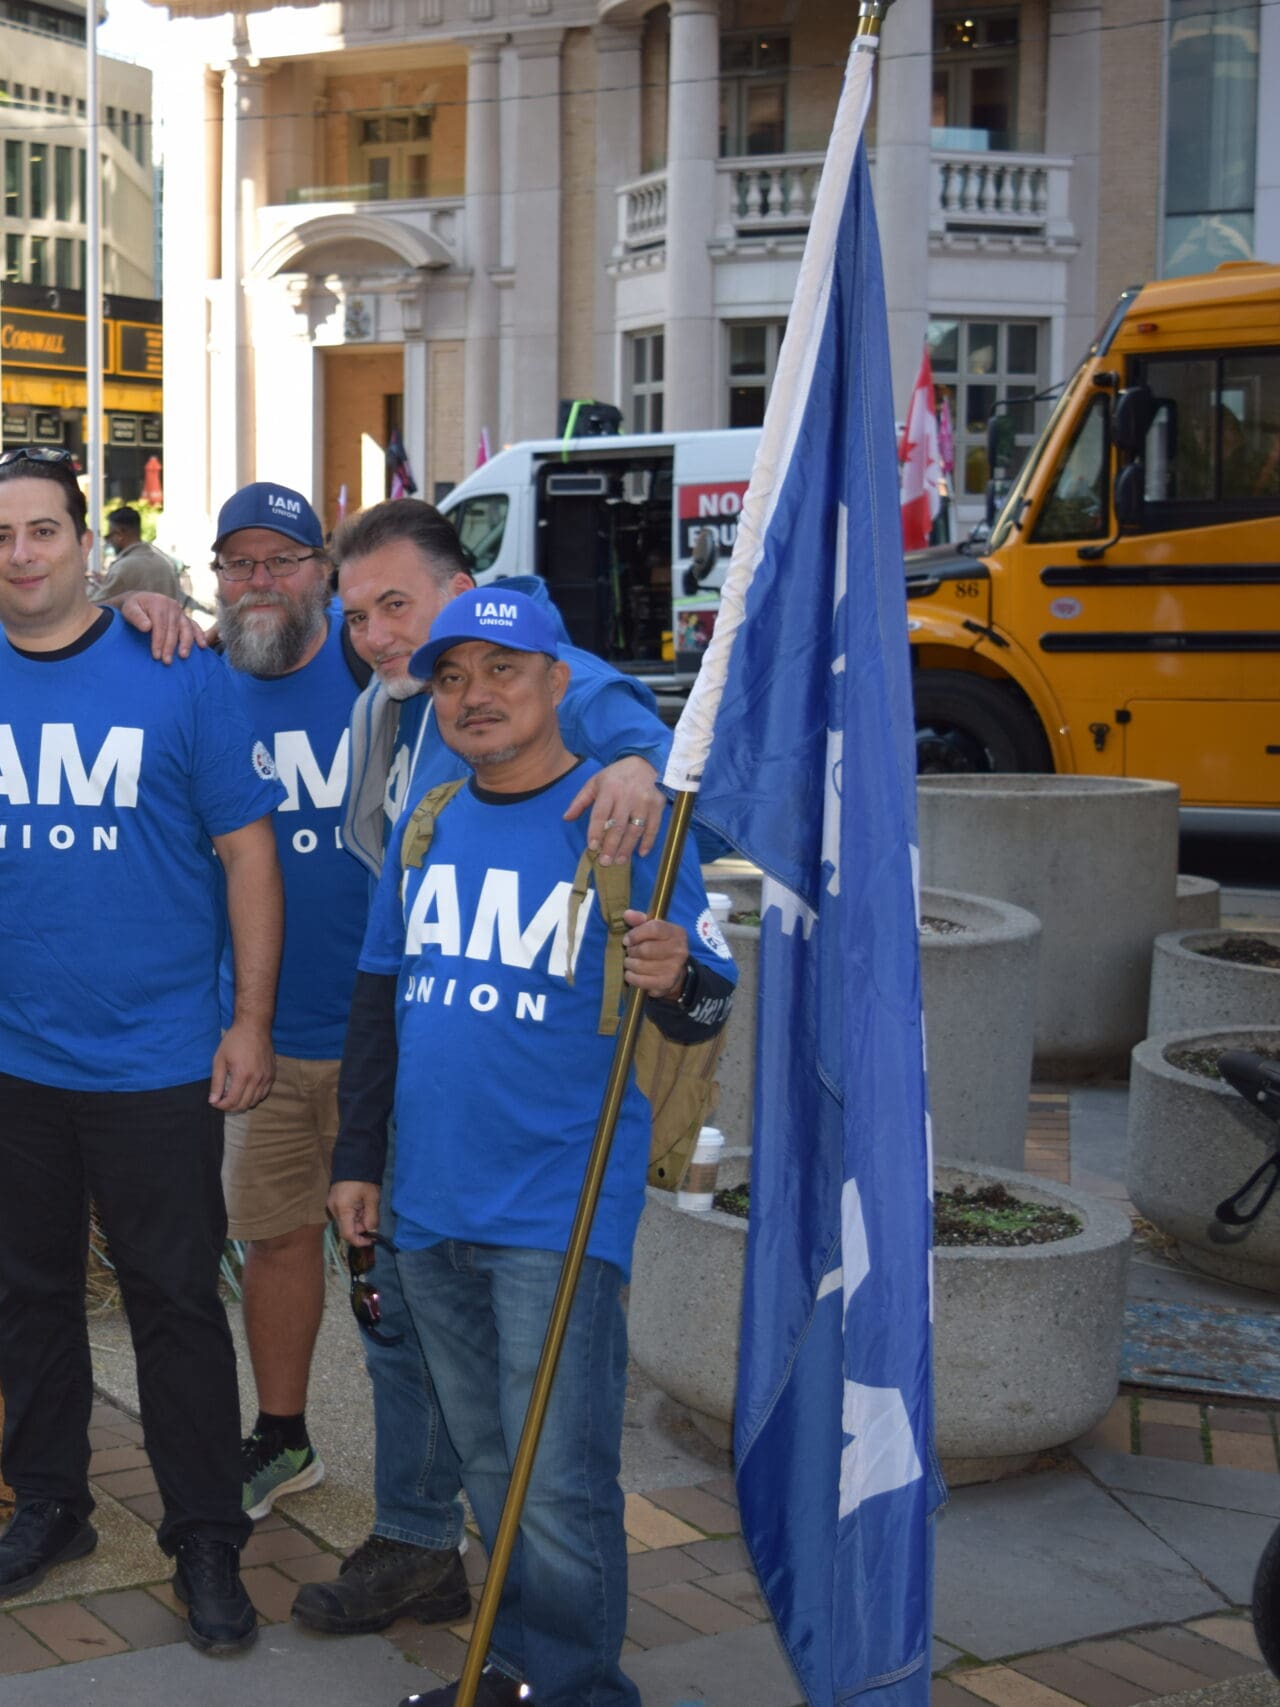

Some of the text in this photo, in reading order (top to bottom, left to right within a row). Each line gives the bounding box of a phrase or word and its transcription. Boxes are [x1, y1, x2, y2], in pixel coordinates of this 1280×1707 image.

[268, 494, 301, 514] IAM
[271, 507, 299, 520] UNION
[955, 583, 980, 598] 86
[475, 602, 518, 620] IAM
[479, 618, 513, 627] UNION
[402, 864, 595, 977] AM
[405, 975, 547, 1021] UNION
